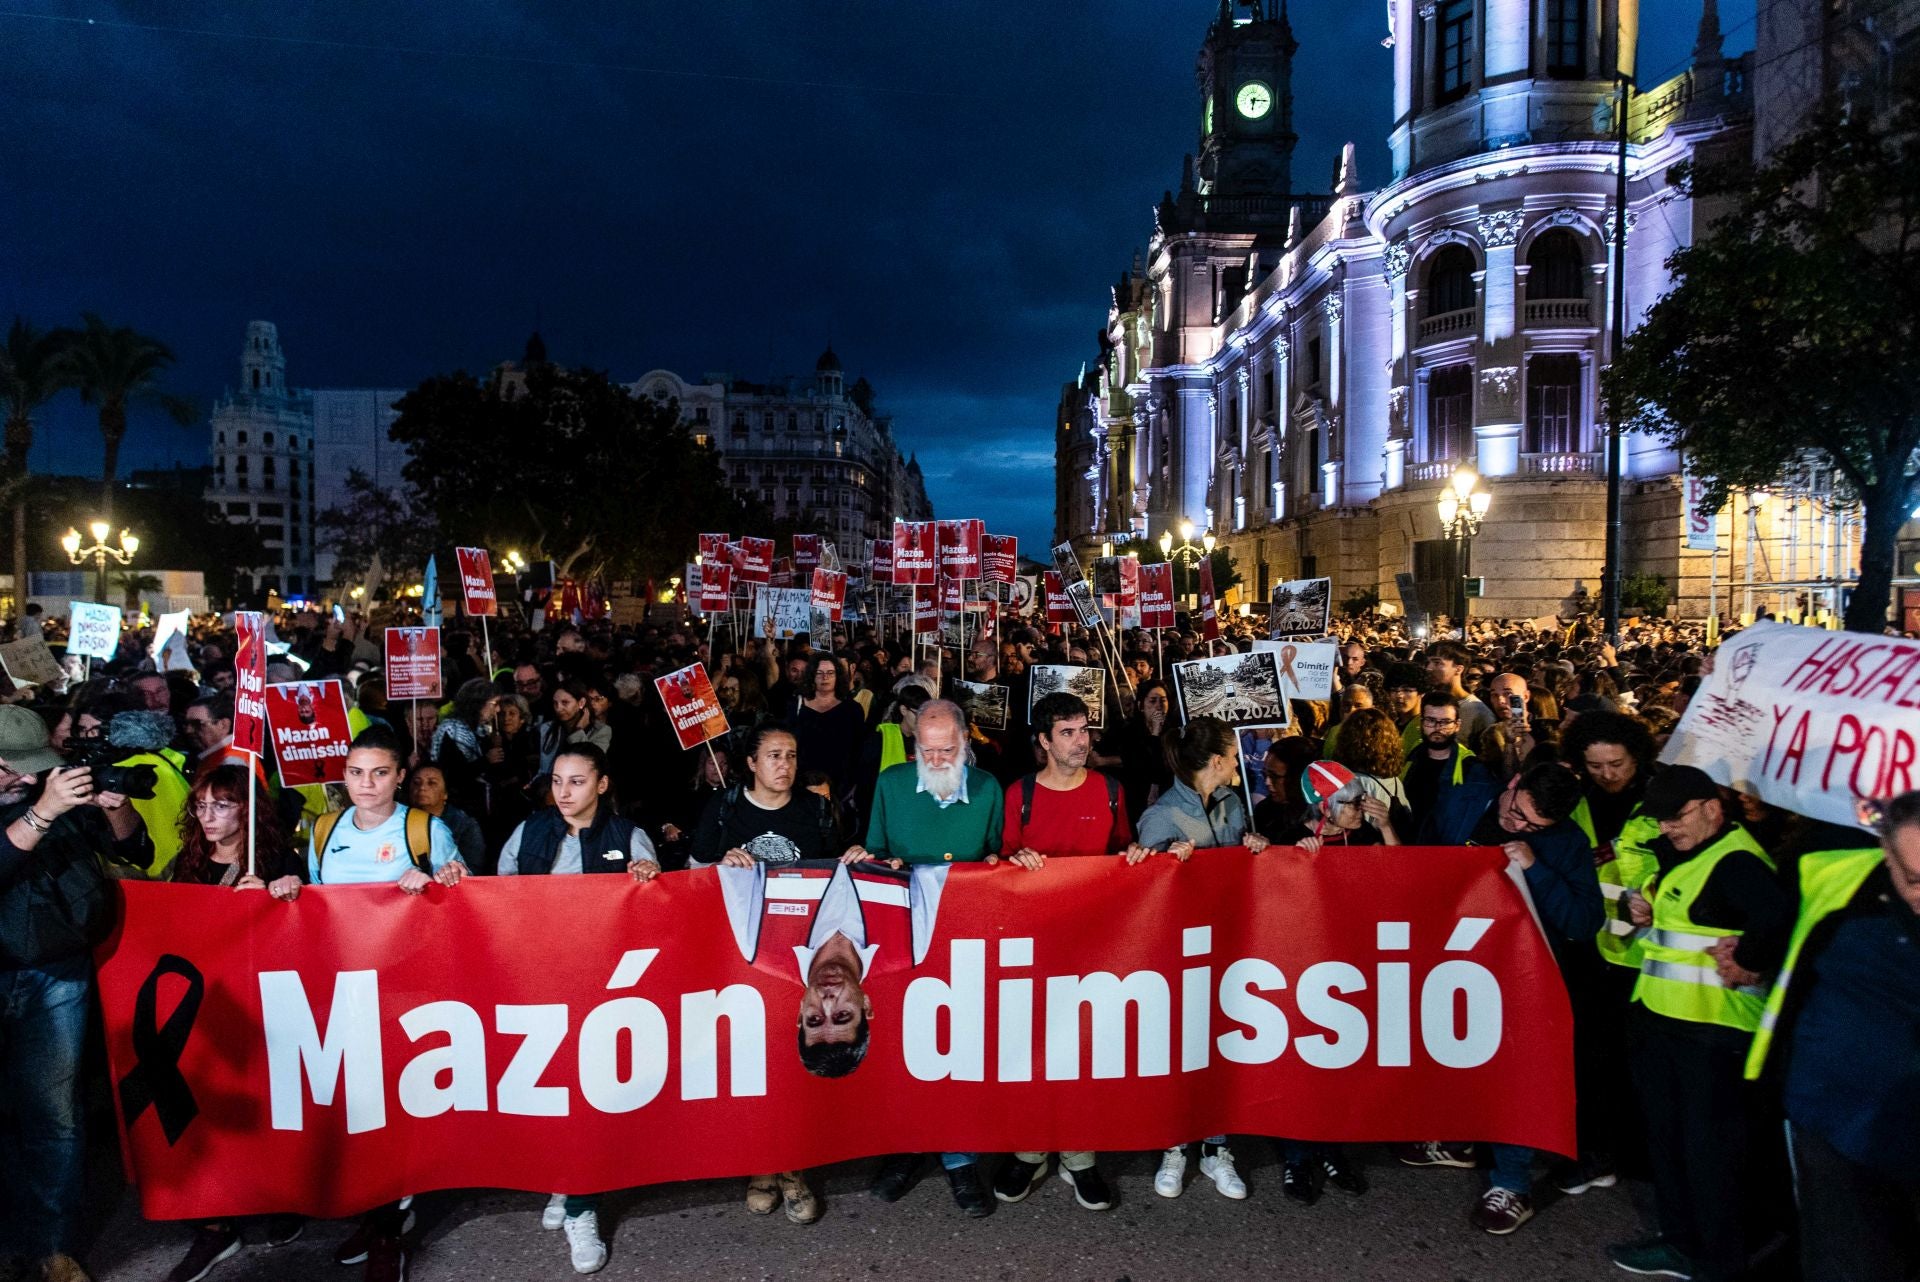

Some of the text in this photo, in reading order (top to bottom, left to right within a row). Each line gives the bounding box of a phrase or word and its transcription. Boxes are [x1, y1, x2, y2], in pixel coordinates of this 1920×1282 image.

[897, 548, 924, 557] Mazón
[941, 544, 968, 554] Mazón
[897, 558, 932, 568] dimissió
[942, 554, 977, 565] dimissió
[468, 587, 494, 599] dimissió
[702, 583, 721, 591] Mazón
[702, 591, 728, 600] dimissió
[814, 589, 835, 599] Mazón
[1141, 590, 1163, 601] Mazón
[813, 598, 841, 609] dimissió
[1142, 600, 1171, 613] dimissió
[796, 605, 801, 615] A
[1296, 619, 1323, 631] 2024
[1782, 637, 1920, 702] HASTA
[672, 698, 705, 718] Mazón
[1243, 704, 1281, 720] 2024
[678, 704, 719, 730] dimissió
[277, 723, 330, 744] Mazón
[282, 740, 349, 761] dimissió
[1761, 704, 1915, 799] YA POR
[258, 917, 1503, 1134] Mazón dimissió
